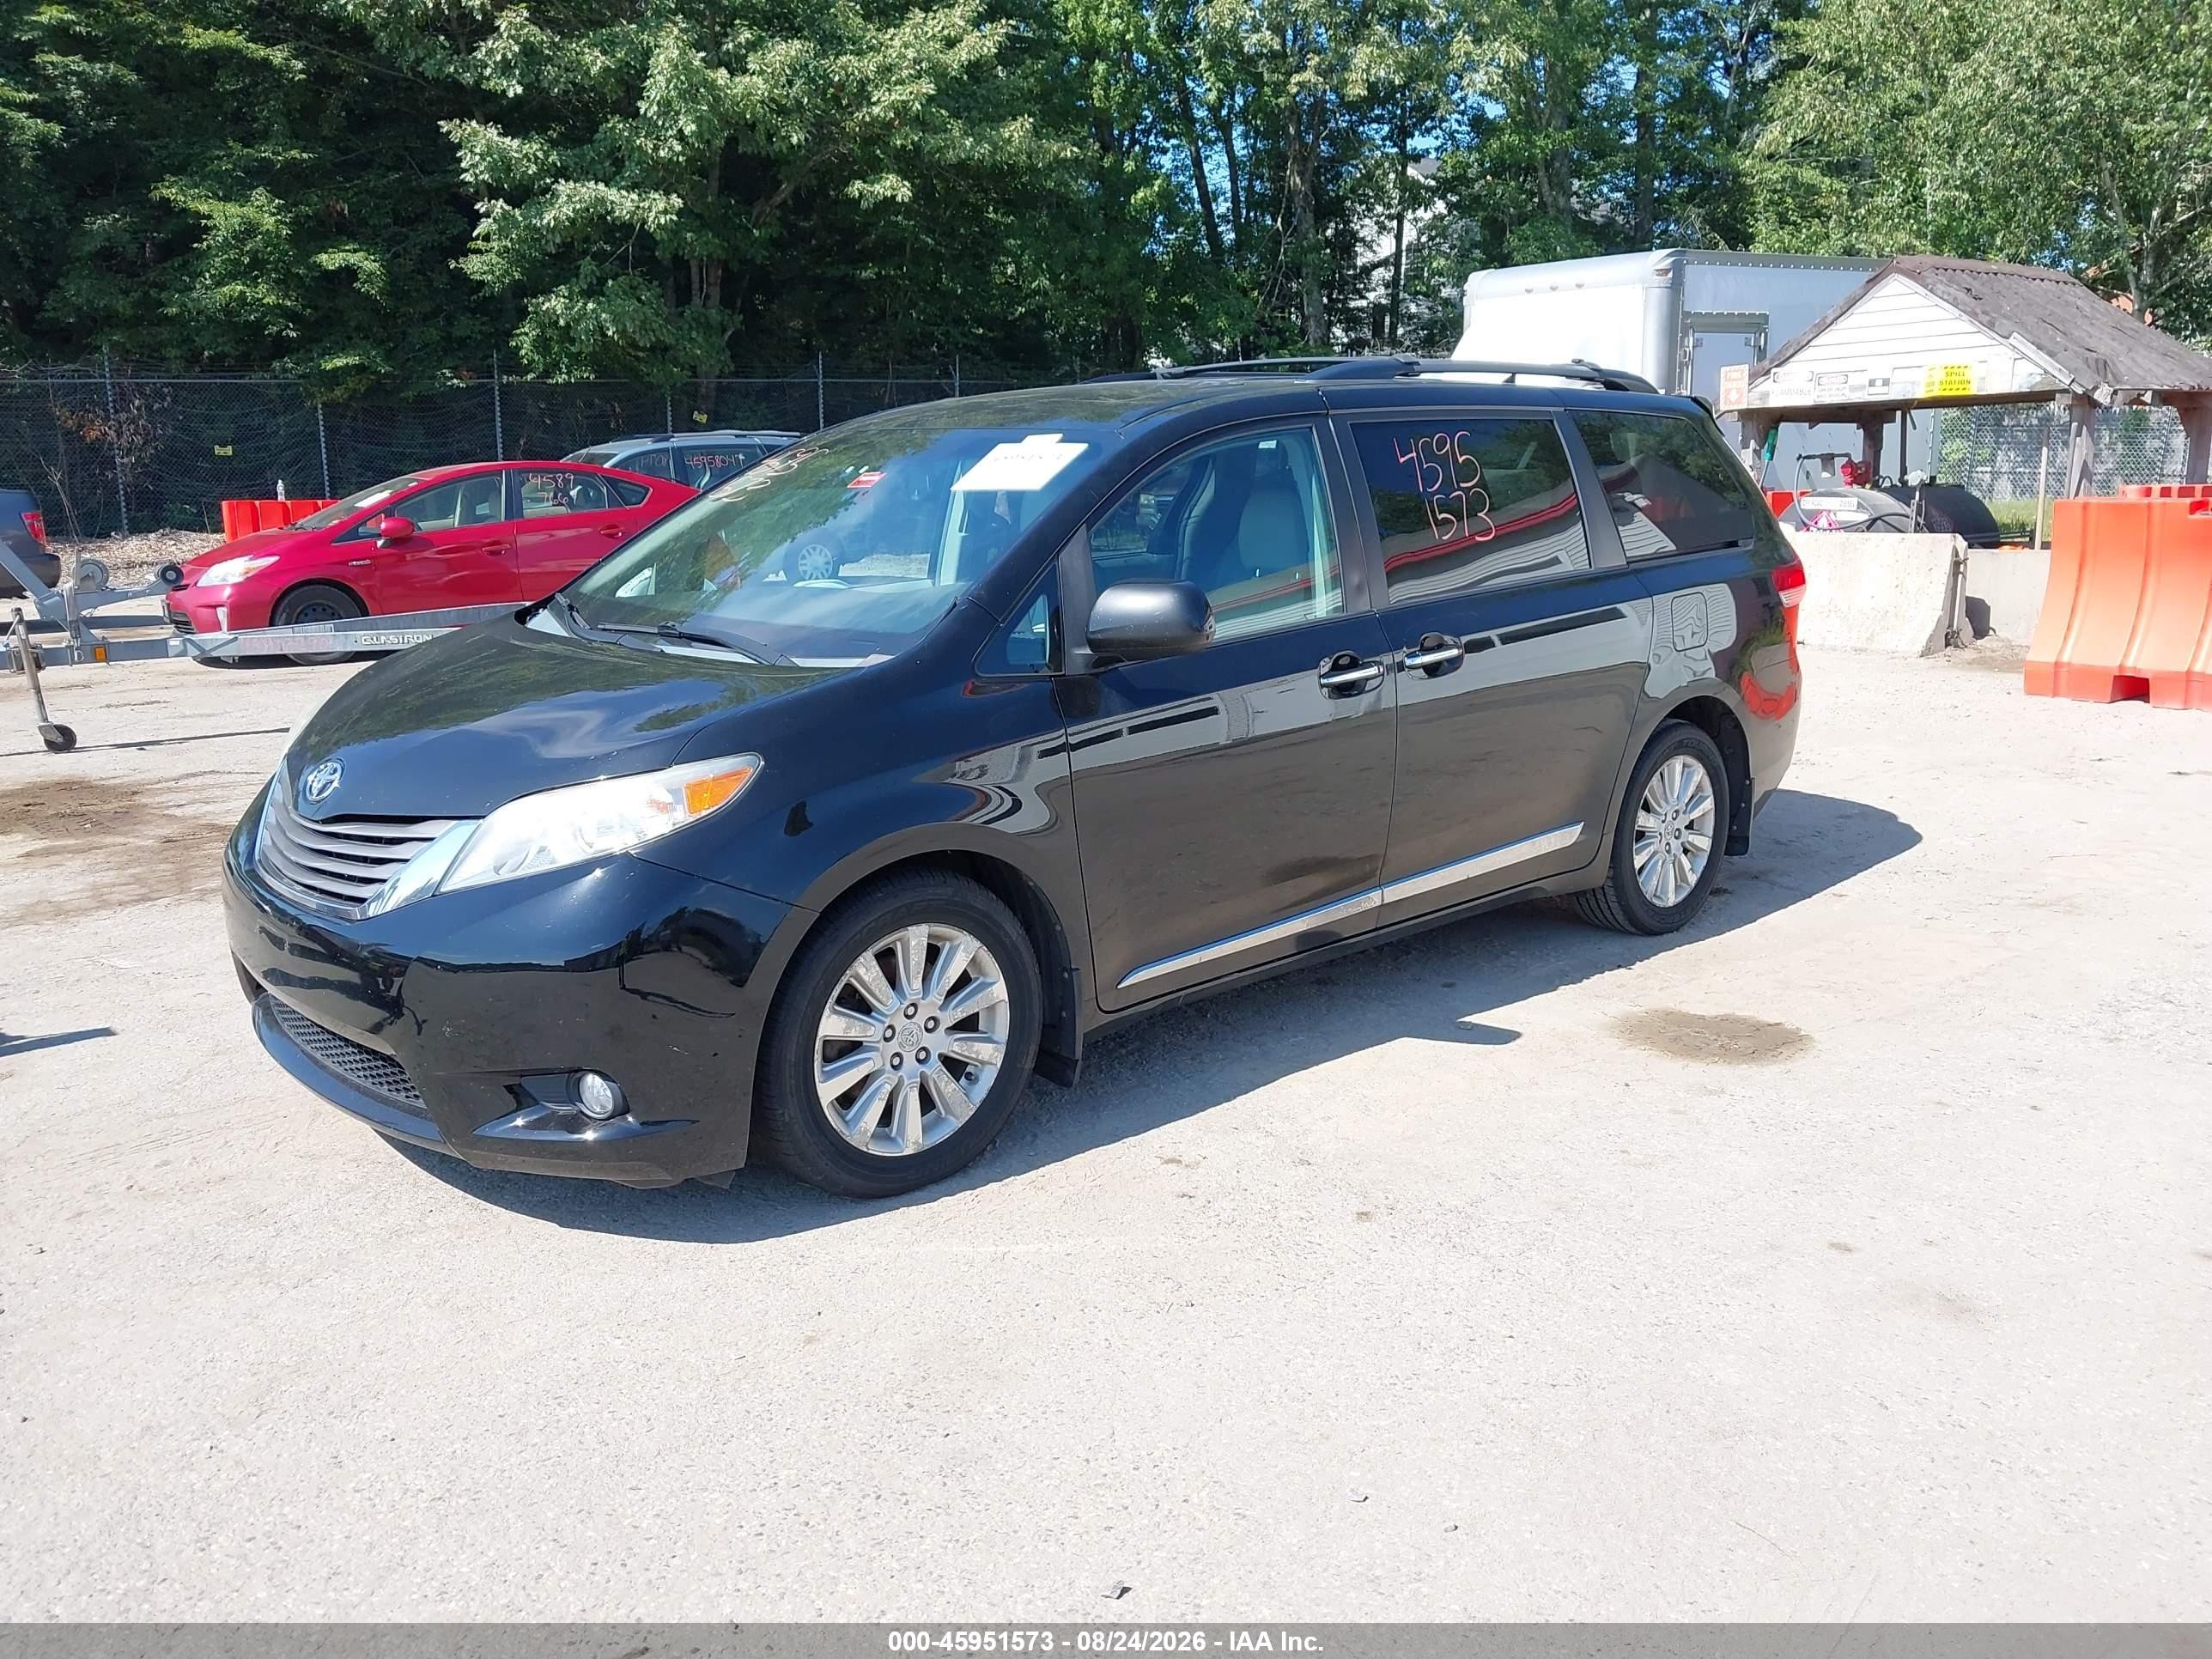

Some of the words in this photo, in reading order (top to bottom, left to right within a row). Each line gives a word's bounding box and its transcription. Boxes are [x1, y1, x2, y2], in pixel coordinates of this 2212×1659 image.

[1393, 431, 1480, 492] 4595
[529, 472, 574, 490] 4589
[537, 491, 569, 506] 766
[1425, 488, 1496, 541] 1573
